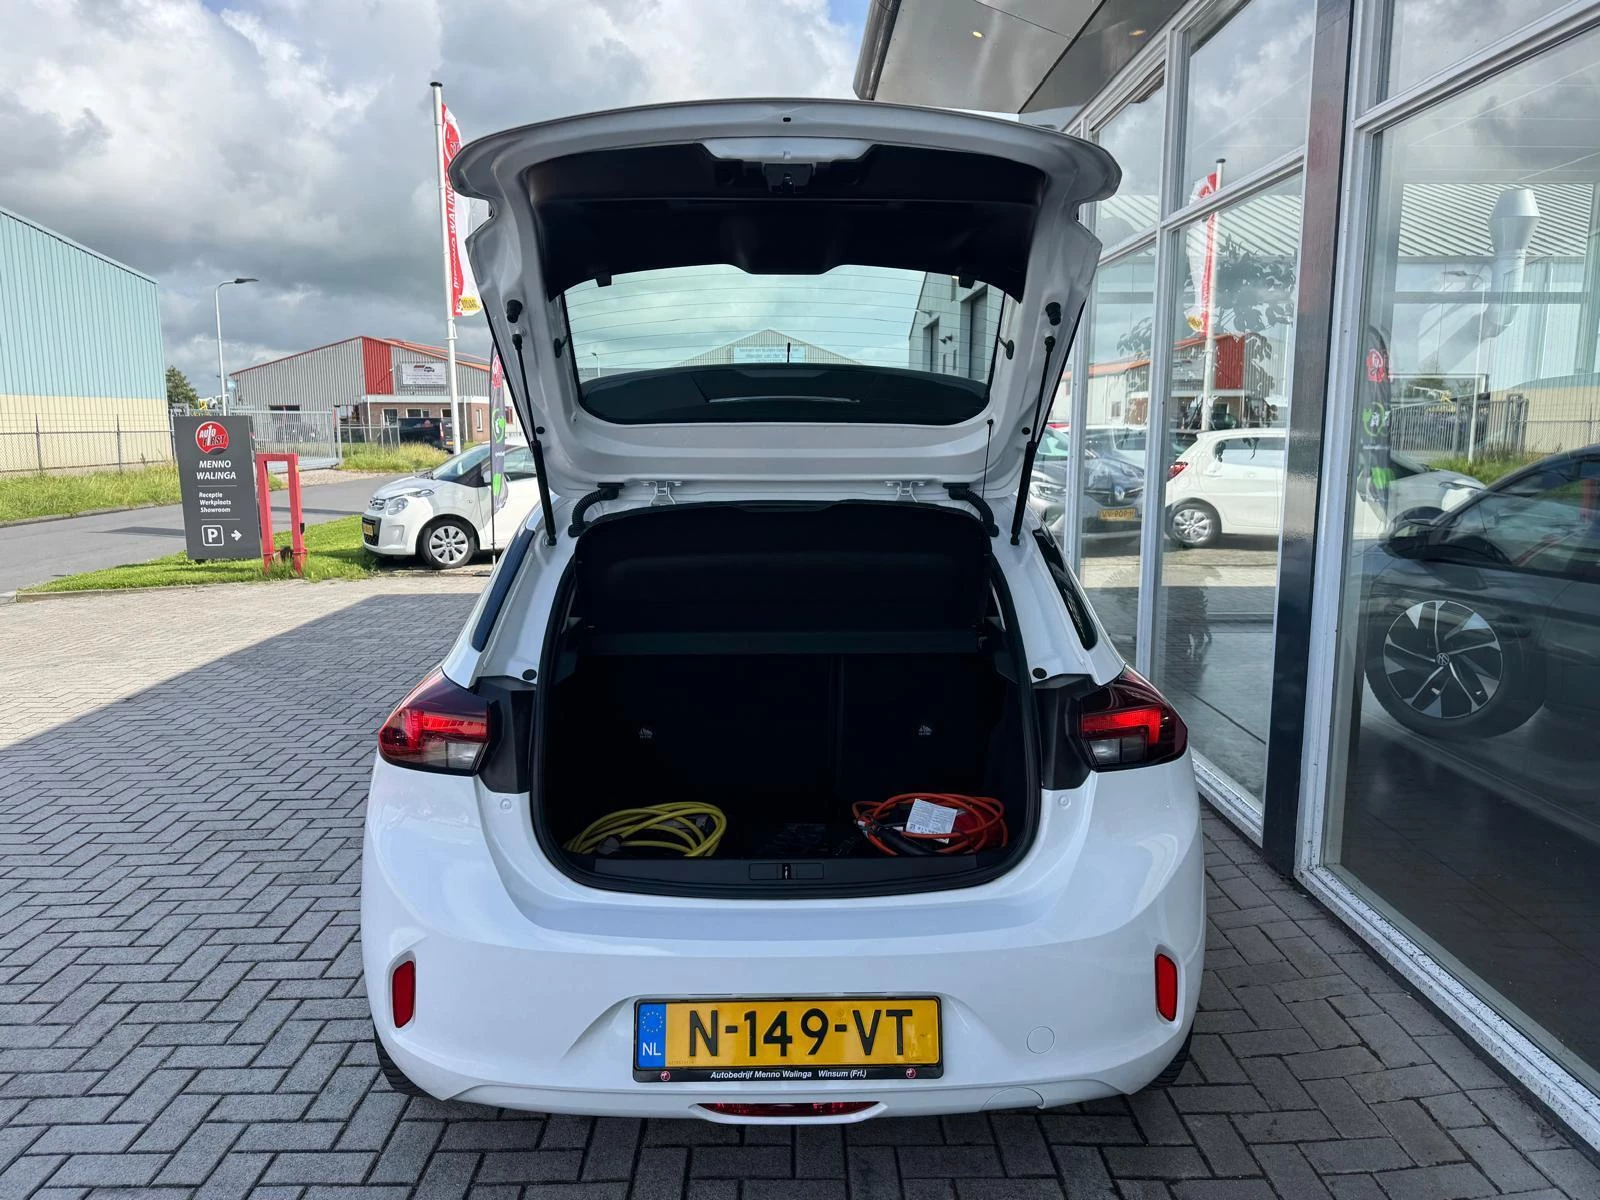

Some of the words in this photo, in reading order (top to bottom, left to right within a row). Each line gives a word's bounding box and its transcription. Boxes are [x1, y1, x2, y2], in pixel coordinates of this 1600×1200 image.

[199, 460, 231, 468] MENNO
[196, 471, 236, 479] WALINGA
[207, 528, 218, 543] P
[689, 1008, 913, 1057] N-149-VT
[642, 1042, 662, 1056] NL
[710, 1071, 752, 1080] Autobedrijf
[754, 1070, 780, 1078] Menno
[782, 1070, 812, 1079] Walinga
[818, 1070, 848, 1078] Winsum
